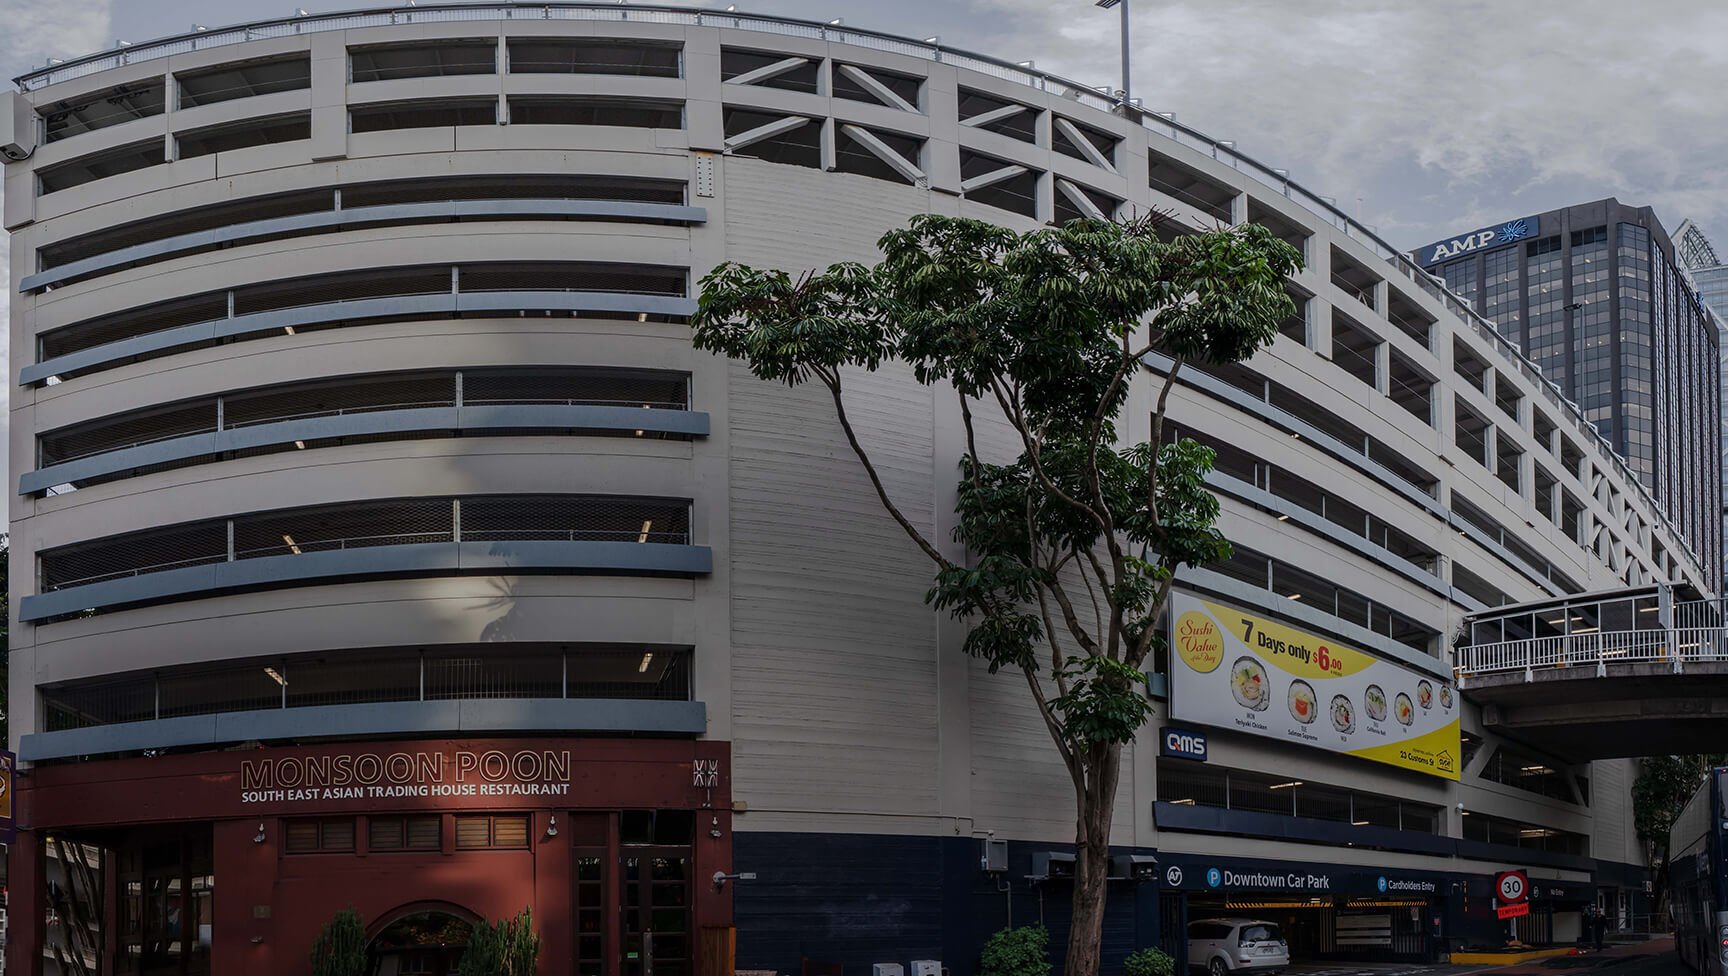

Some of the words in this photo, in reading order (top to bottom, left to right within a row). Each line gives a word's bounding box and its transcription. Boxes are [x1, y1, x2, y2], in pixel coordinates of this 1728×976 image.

[1430, 231, 1495, 262] AMP
[1180, 619, 1213, 636] Sushi
[1181, 636, 1217, 653] Value
[1241, 618, 1254, 643] 7
[1258, 631, 1285, 655] Days
[1288, 645, 1311, 664] only
[1312, 646, 1342, 671] $6.00
[1235, 718, 1251, 727] Teriyaki
[1252, 722, 1267, 730] Chicken
[1288, 729, 1302, 738] Salmon
[1167, 733, 1205, 755] QMS
[1408, 753, 1428, 765] Customs
[241, 751, 443, 789] MONSOON
[455, 750, 571, 782] POON
[242, 789, 284, 803] SOUTH
[287, 788, 320, 801] EAST
[322, 786, 364, 800] ASIAN
[367, 785, 428, 799] TRADING
[431, 784, 476, 797] HOUSE
[480, 783, 570, 796] RESTAURANT
[1210, 871, 1218, 883] P
[1224, 870, 1285, 887] Downtown
[1287, 873, 1305, 888] Car
[1307, 874, 1330, 889] Park
[1388, 880, 1421, 891] Cardholders
[1421, 881, 1435, 893] Entry
[1504, 880, 1521, 894] 30
